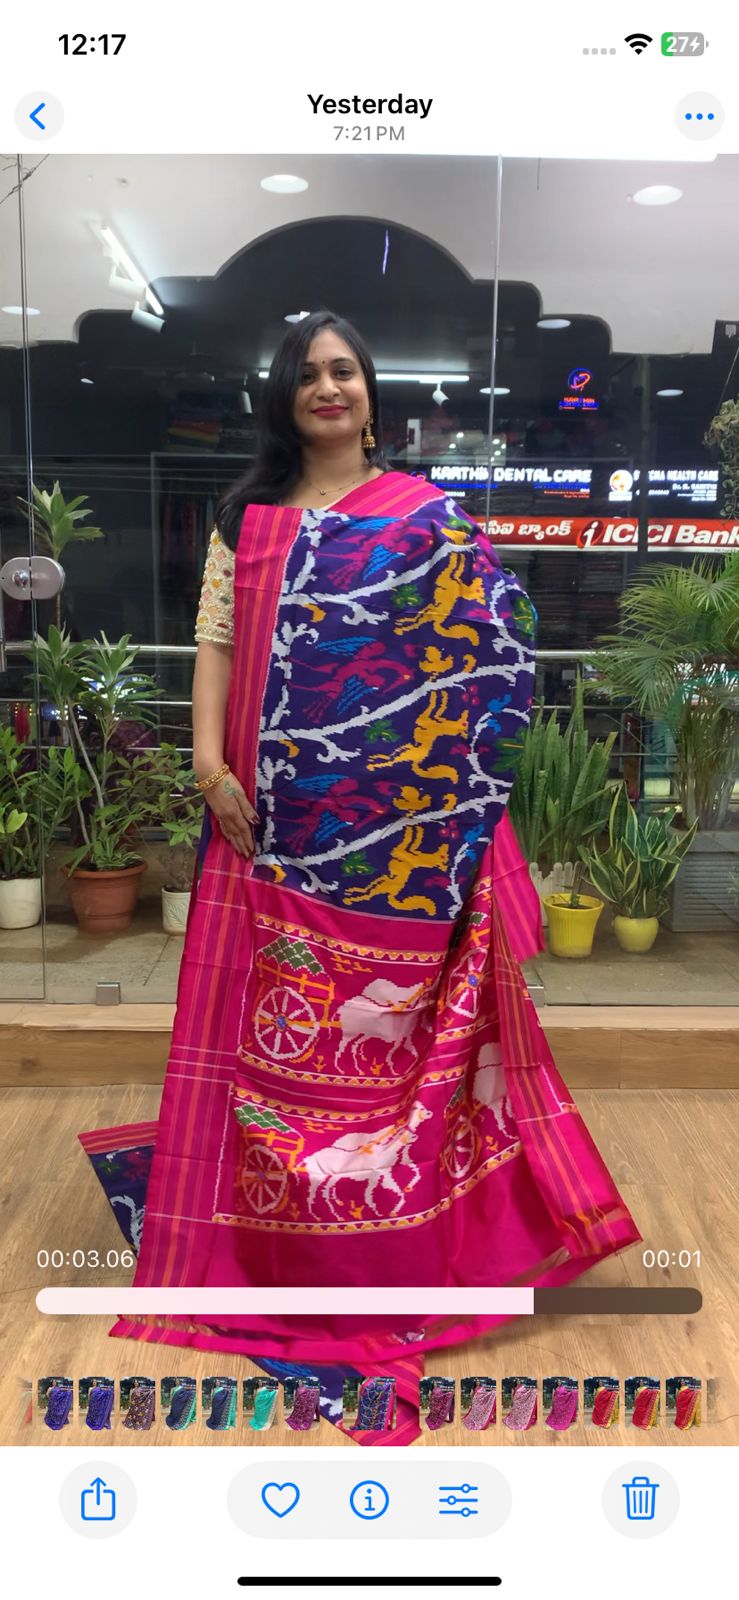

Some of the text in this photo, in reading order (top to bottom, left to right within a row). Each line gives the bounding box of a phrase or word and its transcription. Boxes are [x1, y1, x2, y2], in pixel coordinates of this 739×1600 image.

[494, 467, 553, 482] DENTAL
[553, 469, 593, 483] CARE
[666, 470, 697, 481] HEALTH
[698, 470, 719, 481] CARE
[602, 523, 674, 543] ICICI
